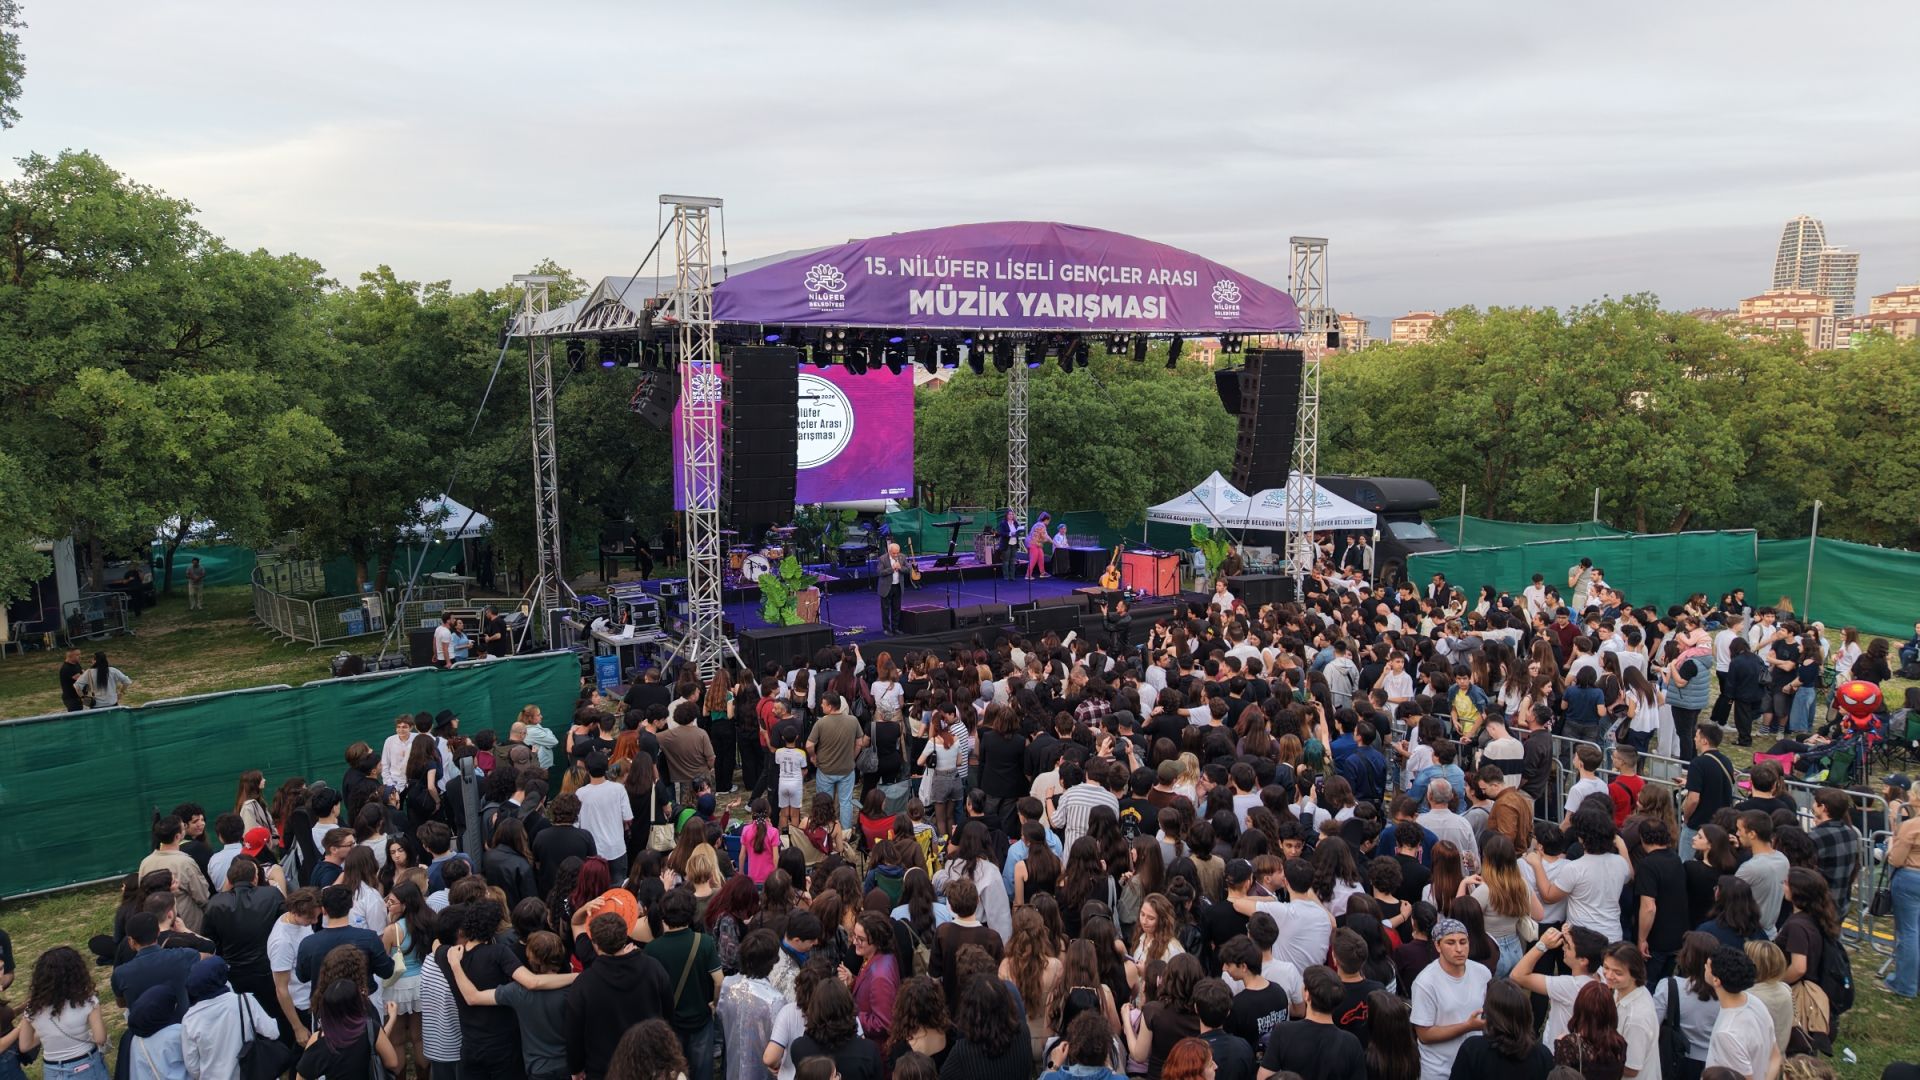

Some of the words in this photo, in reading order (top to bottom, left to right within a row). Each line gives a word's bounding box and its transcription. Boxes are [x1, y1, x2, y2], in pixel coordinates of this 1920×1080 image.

[864, 256, 893, 276] 15.
[899, 254, 989, 279] NİLÜFER
[995, 258, 1054, 281] LİSELİ
[1059, 264, 1143, 286] GENÇLER
[1147, 268, 1198, 287] ARASI
[808, 292, 846, 301] NİLÜFER
[909, 283, 1010, 317] MÜZİK
[1016, 292, 1167, 323] YARIŞMASI
[800, 407, 821, 418] lüfer
[820, 418, 842, 429] Arası
[798, 431, 836, 441] arışması
